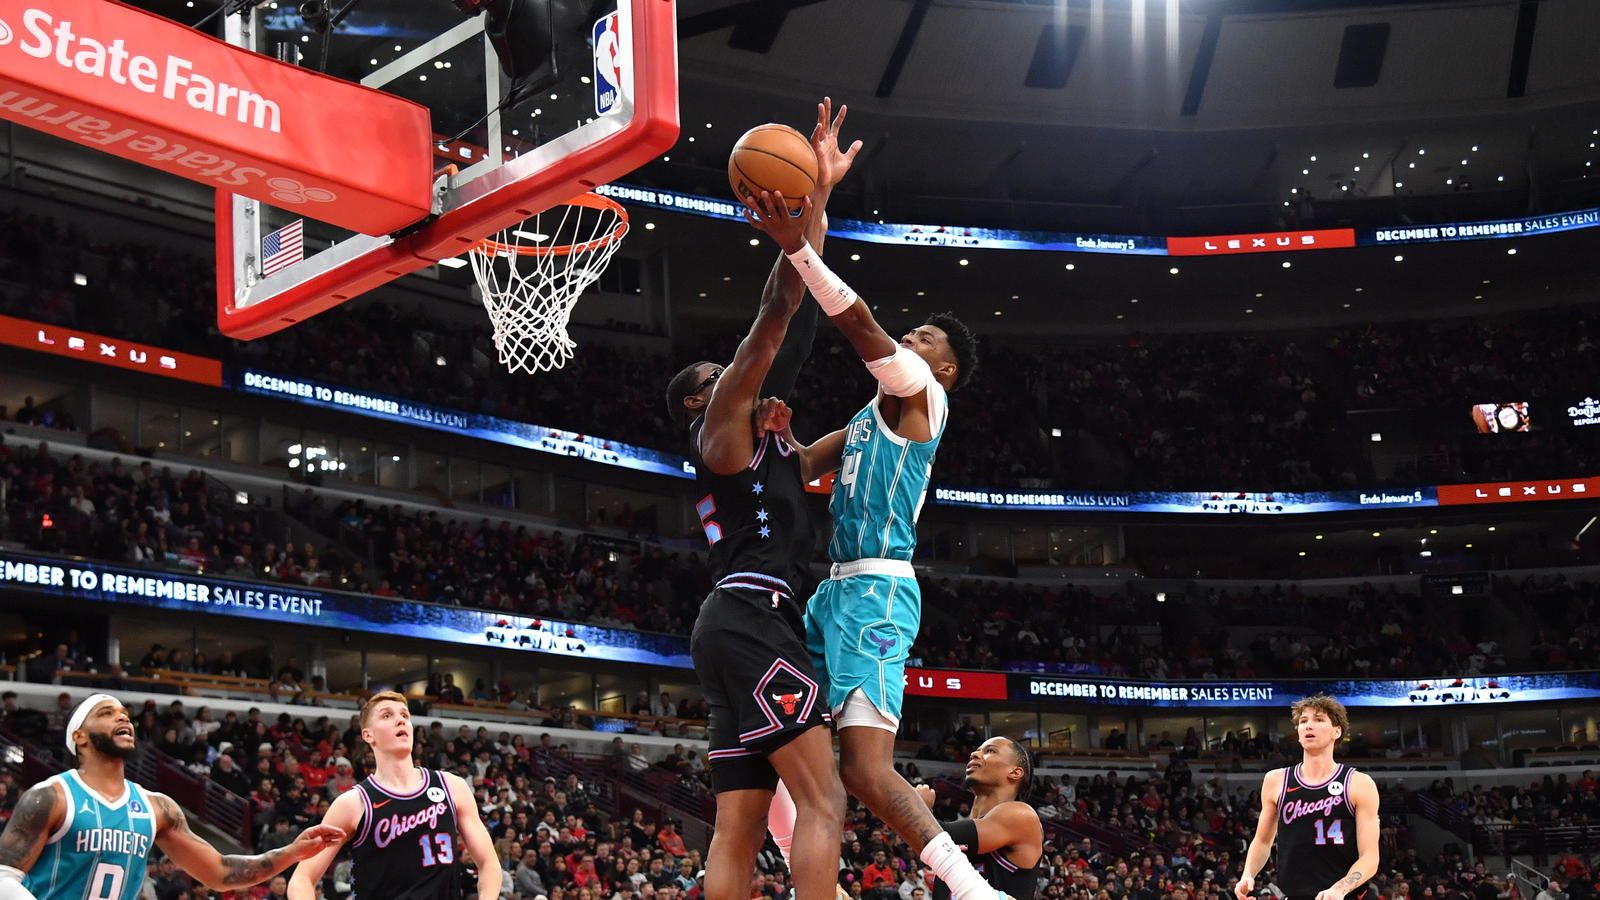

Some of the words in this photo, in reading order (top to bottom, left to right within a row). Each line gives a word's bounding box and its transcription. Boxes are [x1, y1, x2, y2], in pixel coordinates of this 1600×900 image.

[600, 89, 615, 110] NBA
[595, 184, 656, 203] DECEMBER
[657, 193, 674, 206] TO
[675, 195, 735, 216] REMEMBER
[1376, 228, 1438, 241] DECEMBER
[1440, 226, 1457, 238] TO
[1459, 222, 1523, 237] REMEMBER
[1525, 218, 1559, 231] SALES
[1561, 211, 1599, 227] EVENT
[1076, 237, 1096, 248] Ends
[1096, 238, 1128, 251] January
[1128, 239, 1135, 250] 5
[1204, 235, 1315, 250] LEXUS
[38, 330, 177, 369] LEXUS
[244, 372, 313, 399] DECEMBER
[315, 387, 333, 401] TO
[334, 390, 400, 415] REMEMBER
[936, 488, 988, 504] DECEMBER
[990, 493, 1004, 505] TO
[1006, 494, 1065, 505] REMEMBER
[1359, 493, 1381, 505] Ends
[1381, 493, 1414, 505] January
[1414, 491, 1422, 502] 5
[1475, 483, 1586, 498] LEXUS
[69, 569, 98, 591] TO
[102, 573, 210, 603] REMEMBER
[213, 586, 265, 610] SALES
[268, 593, 323, 616] EVENT
[1030, 681, 1097, 698] DECEMBER
[1099, 684, 1116, 699] TO
[1119, 685, 1188, 701] REMEMBER
[1190, 688, 1229, 701] SALES
[1232, 687, 1274, 701] EVENT
[1282, 795, 1344, 825] Chicago
[374, 802, 448, 849] Chicago
[1313, 819, 1345, 845] 14
[76, 828, 149, 859] HORNETS
[419, 832, 454, 867] 13
